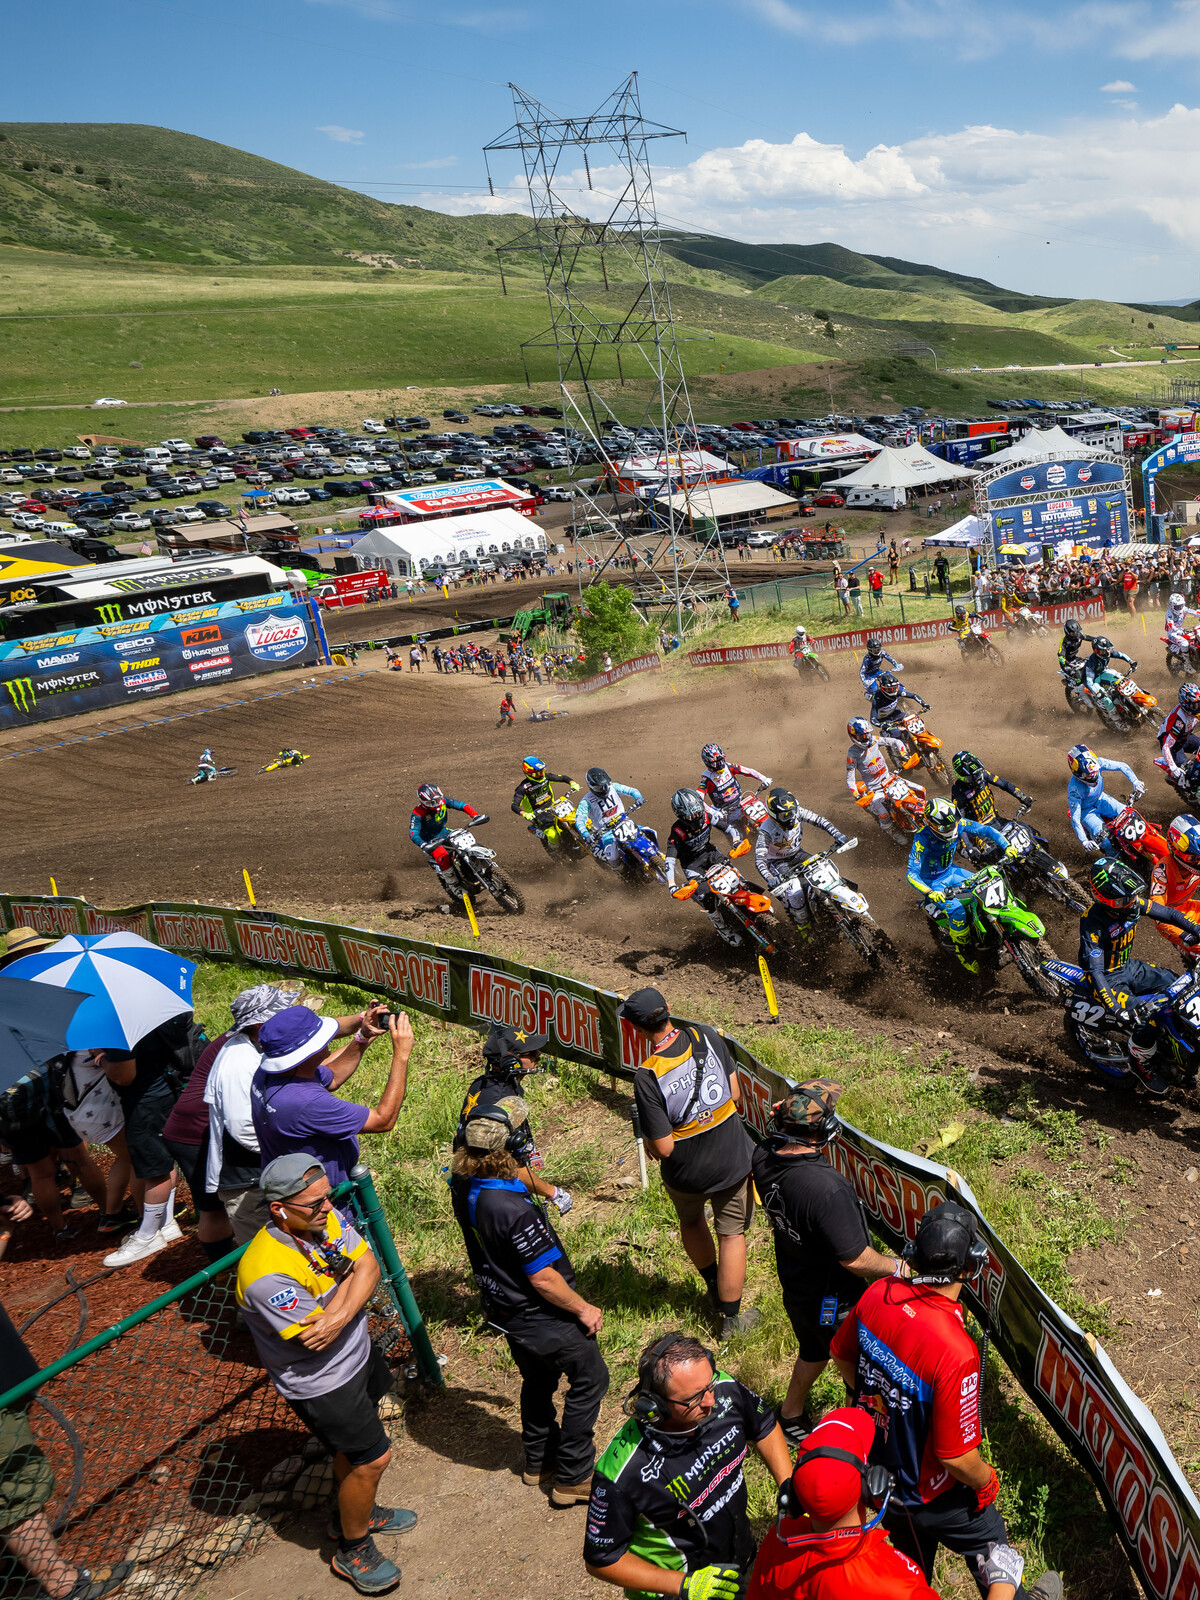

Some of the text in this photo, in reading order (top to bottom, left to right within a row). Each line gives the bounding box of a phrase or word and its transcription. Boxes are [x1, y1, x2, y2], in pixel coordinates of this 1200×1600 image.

[425, 490, 507, 506] GASGAS
[1048, 500, 1073, 510] LUCAS OIL
[1041, 509, 1083, 521] MOTOCROSS
[128, 591, 216, 615] MONSTER
[173, 610, 203, 619] Thunder
[200, 607, 220, 619] MX
[101, 623, 135, 633] Thunder
[133, 620, 152, 632] MX
[690, 653, 711, 664] LUCAS
[711, 651, 723, 663] OIL
[725, 651, 744, 662] LUCAS
[744, 649, 755, 660] OIL
[757, 647, 777, 658] LUCAS
[828, 636, 850, 649] LUCAS
[851, 633, 863, 647] OIL
[866, 629, 893, 643] LUCAS
[893, 628, 908, 642] OIL
[911, 624, 937, 639] LUCAS
[983, 613, 999, 629] OIL
[1054, 605, 1085, 624] LUCAS
[1086, 602, 1104, 618] OIL
[23, 636, 58, 648] Thunder
[56, 634, 78, 646] MX
[113, 637, 155, 651] GEICO
[185, 628, 219, 645] KTM
[255, 626, 300, 645] LUCAS
[191, 644, 229, 657] Husqvarna
[267, 640, 305, 651] PRODUCTS
[274, 650, 290, 658] INC.
[128, 657, 161, 670] THOR
[190, 657, 230, 670] GASGAS
[631, 658, 652, 671] LUCAS
[36, 671, 100, 691] MONSTER
[123, 669, 165, 682] PARTS
[125, 675, 167, 687] UNLIMITED
[202, 668, 233, 678] DUNLOP
[49, 682, 92, 695] ENERGY
[598, 795, 615, 812] FLY
[970, 785, 991, 808] THOR
[1123, 820, 1146, 841] 96
[713, 873, 740, 896] 38
[985, 879, 1006, 907] 47
[11, 904, 77, 935] MOTOSPORT
[154, 914, 229, 952] MOTOSPORT
[236, 920, 332, 971] MOTOSPORT
[343, 938, 447, 1007] MOTOSPORT
[1099, 987, 1115, 1009] THOR
[471, 967, 600, 1053] MOTOSPORT
[1071, 1001, 1105, 1028] 32
[669, 1056, 716, 1095] PHOO
[698, 1109, 711, 1120] 50
[912, 1276, 951, 1285] SENA
[613, 1426, 635, 1459] FOX
[684, 1425, 740, 1481] MONSTER
[697, 1443, 737, 1481] ENERGY
